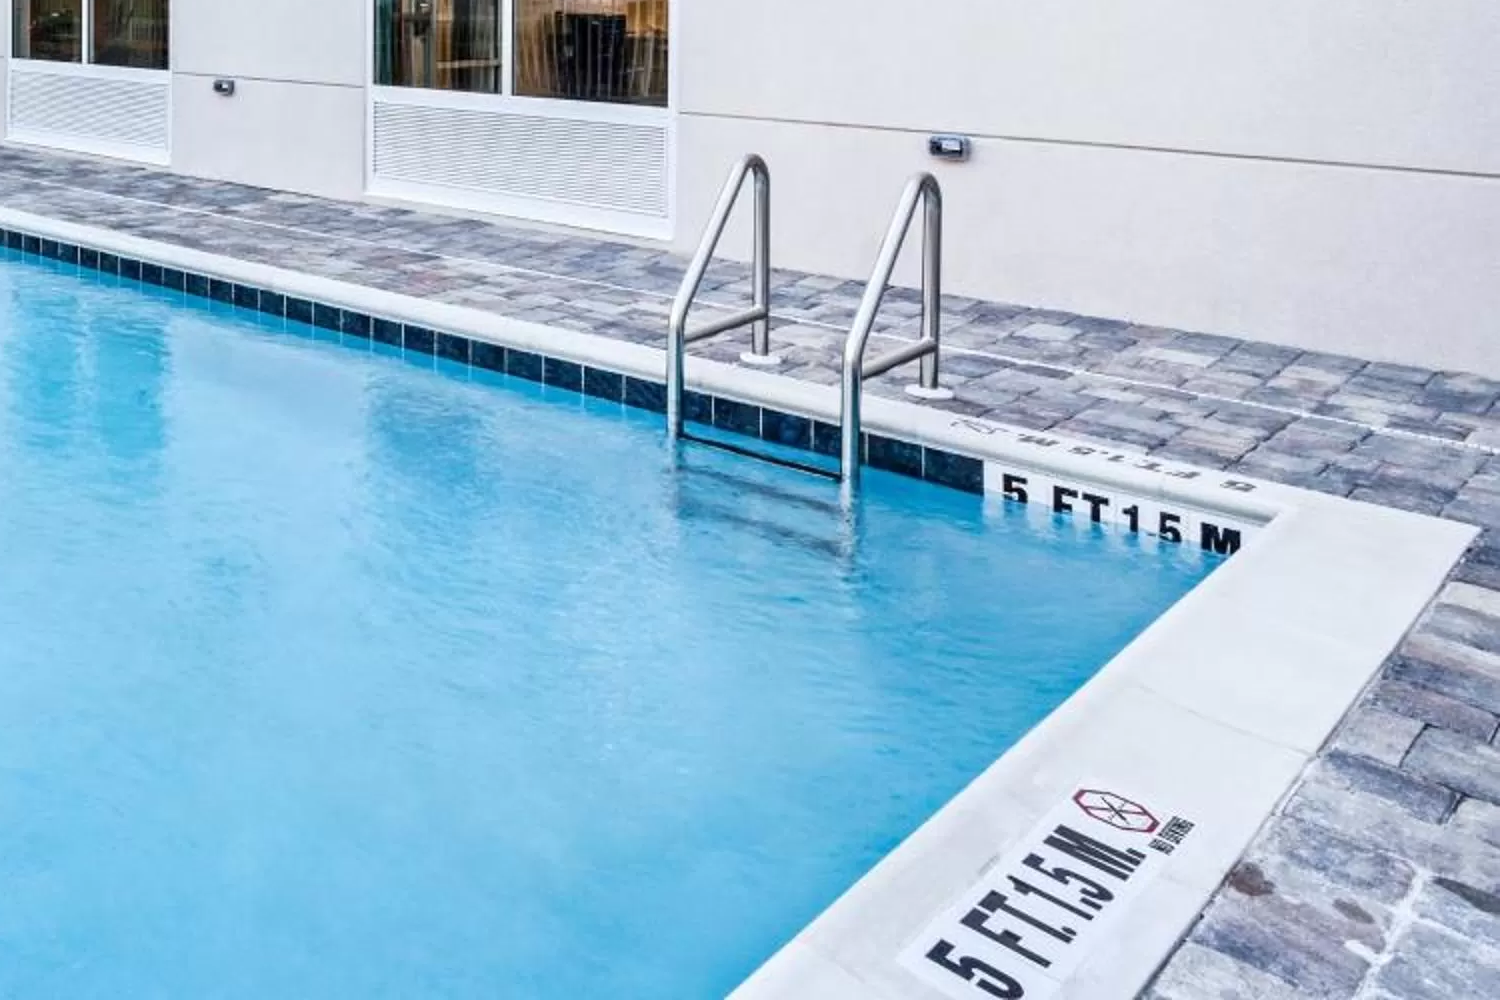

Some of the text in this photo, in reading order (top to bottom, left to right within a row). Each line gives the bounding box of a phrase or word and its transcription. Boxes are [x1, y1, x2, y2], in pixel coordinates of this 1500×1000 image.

[1002, 473, 1241, 555] 5 FT 15 M
[1006, 852, 1115, 922] 1.5
[1042, 823, 1147, 882] M.
[958, 889, 1078, 968] FT.
[925, 938, 1025, 1000] 5
